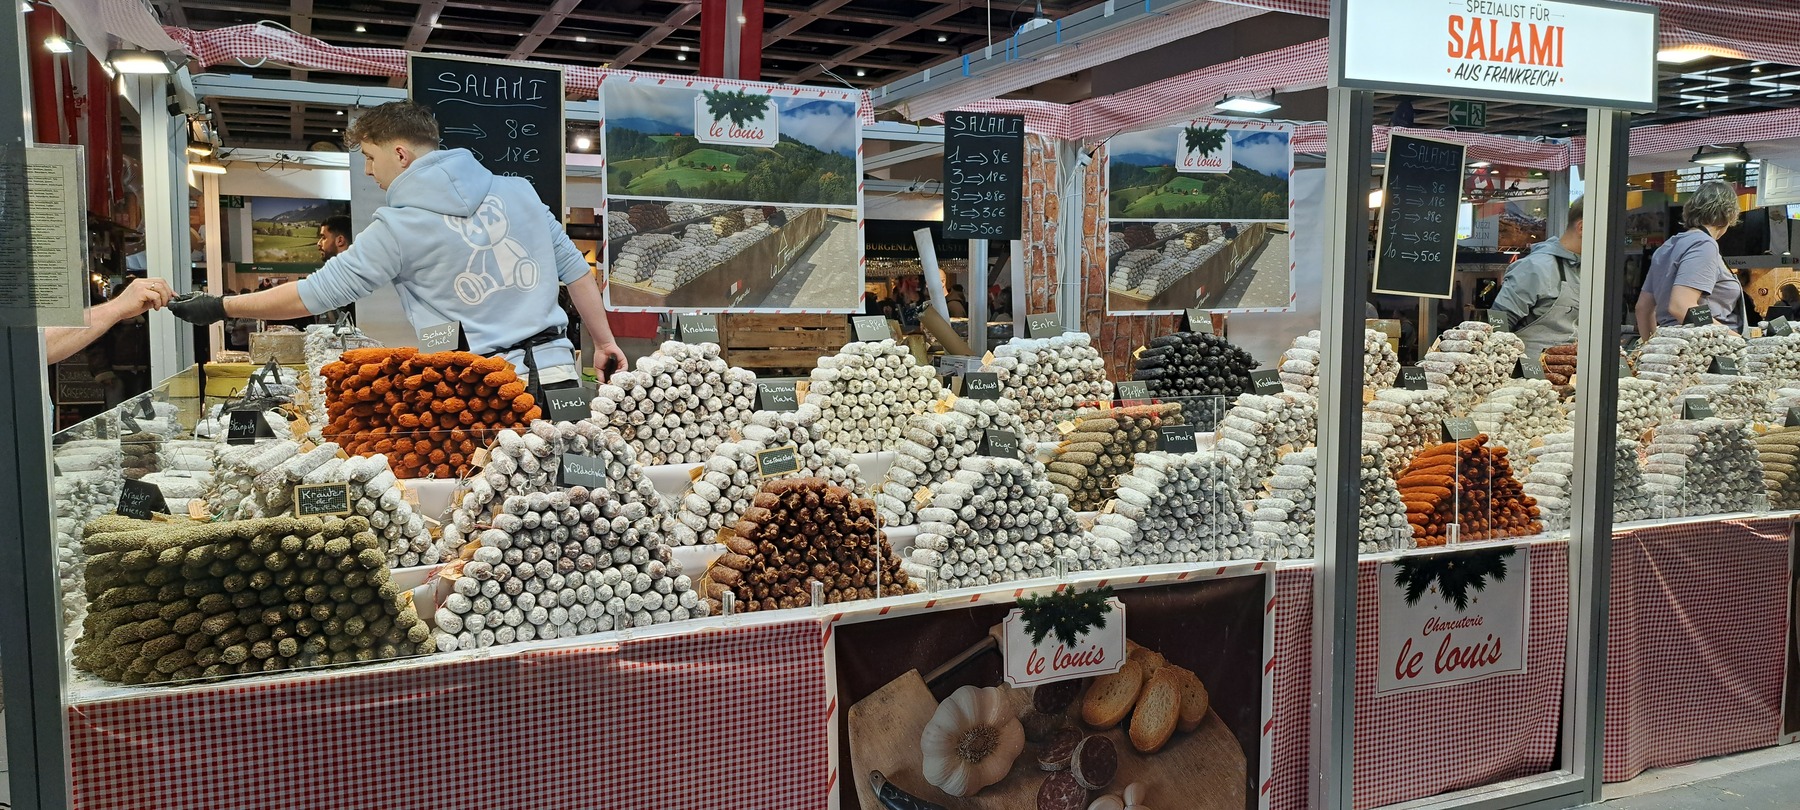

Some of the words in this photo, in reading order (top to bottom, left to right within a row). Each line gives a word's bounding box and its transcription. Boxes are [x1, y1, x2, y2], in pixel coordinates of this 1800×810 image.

[1466, 0, 1526, 18] SPEZIALIST
[1529, 3, 1550, 21] FÜR
[1447, 14, 1565, 67] SALAMI
[1454, 62, 1482, 82] AUS
[1483, 64, 1559, 87] FRANKREICH
[428, 71, 547, 101] SALAMI
[505, 118, 539, 139] 8€
[709, 120, 724, 138] le
[728, 121, 765, 140] louis
[950, 114, 1022, 134] SALAMI
[494, 146, 540, 163] 18€
[947, 145, 961, 165] 1
[992, 148, 1010, 165] 8€
[1183, 153, 1194, 167] le
[1196, 153, 1223, 167] louis
[1401, 143, 1460, 167] SALAMI
[950, 168, 964, 185] 3
[986, 170, 1008, 183] 18€
[1389, 175, 1400, 189] 1
[1432, 181, 1446, 194] 8€
[950, 186, 962, 201] 5
[983, 190, 1006, 202] 28€
[1392, 193, 1401, 206] 3
[1428, 196, 1445, 208] 18€
[951, 203, 959, 216] 7
[982, 206, 1006, 218] 36€
[1391, 208, 1401, 222] 5
[947, 219, 958, 231] 10
[980, 222, 1003, 235] 50€
[1389, 224, 1397, 240] 7
[1422, 230, 1441, 243] 36€
[1384, 243, 1396, 259] 10
[1420, 250, 1441, 262] 50€
[1031, 317, 1057, 331] Ente
[427, 335, 451, 348] Chili
[968, 378, 998, 391] Walnuss
[1119, 385, 1147, 399] Pfeffer
[551, 396, 586, 410] Hirsch
[988, 434, 1014, 453] Feige
[1161, 428, 1194, 443] Tomate
[1422, 614, 1484, 636] Charcuterie
[1026, 648, 1046, 676] le
[1052, 644, 1106, 672] louis
[1395, 636, 1424, 681] le
[1434, 632, 1503, 675] louis
